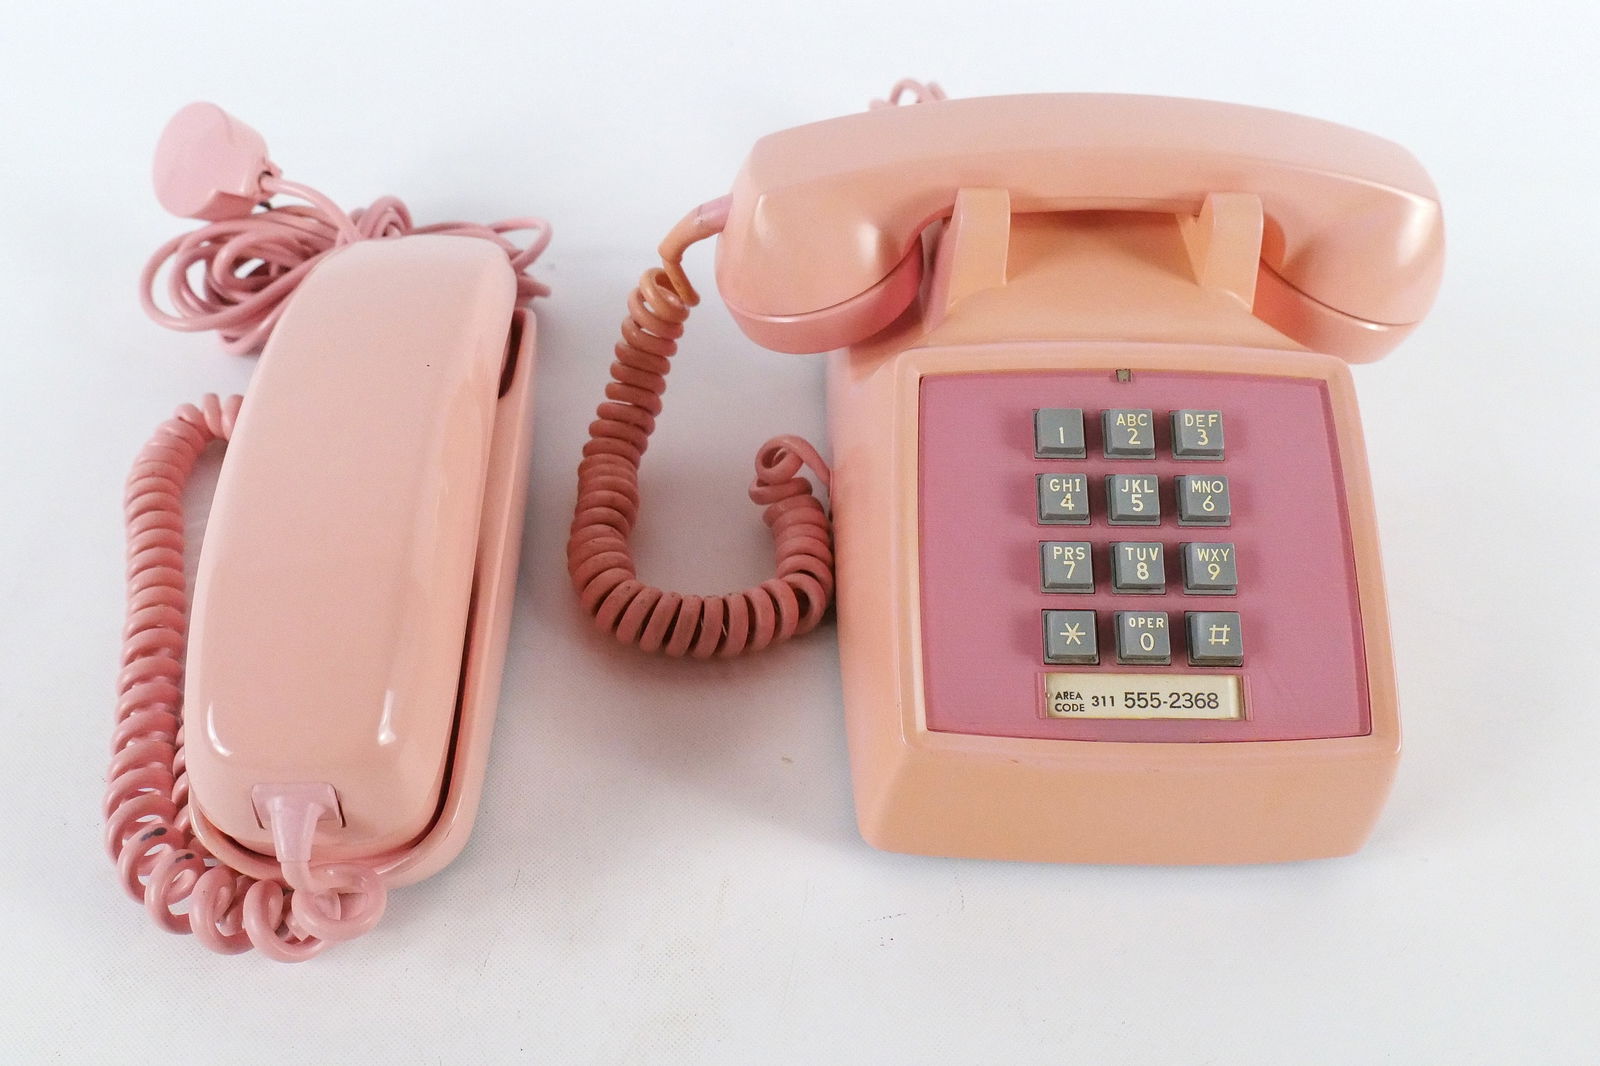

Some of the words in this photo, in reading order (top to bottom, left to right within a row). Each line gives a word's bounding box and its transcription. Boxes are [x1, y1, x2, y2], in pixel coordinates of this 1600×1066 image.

[1116, 413, 1148, 426] ABC
[1184, 413, 1218, 427] DEF
[1058, 427, 1065, 444] 1
[1128, 428, 1141, 445] 2
[1197, 429, 1209, 446] 3
[1049, 478, 1081, 492] GHI
[1121, 479, 1154, 493] JKL
[1191, 480, 1224, 494] MNO
[1060, 493, 1075, 511] 4
[1131, 494, 1144, 512] 5
[1202, 495, 1215, 512] 6
[1053, 546, 1086, 560] PRS
[1125, 547, 1159, 561] TUV
[1197, 548, 1230, 562] WXY
[1063, 560, 1076, 579] 7
[1136, 562, 1149, 580] 8
[1207, 563, 1220, 581] 9
[1128, 617, 1164, 629] OPER
[1055, 691, 1082, 701] AREA
[1091, 695, 1115, 707] 311
[1124, 691, 1219, 709] 555-2368
[1054, 703, 1085, 712] CODE
